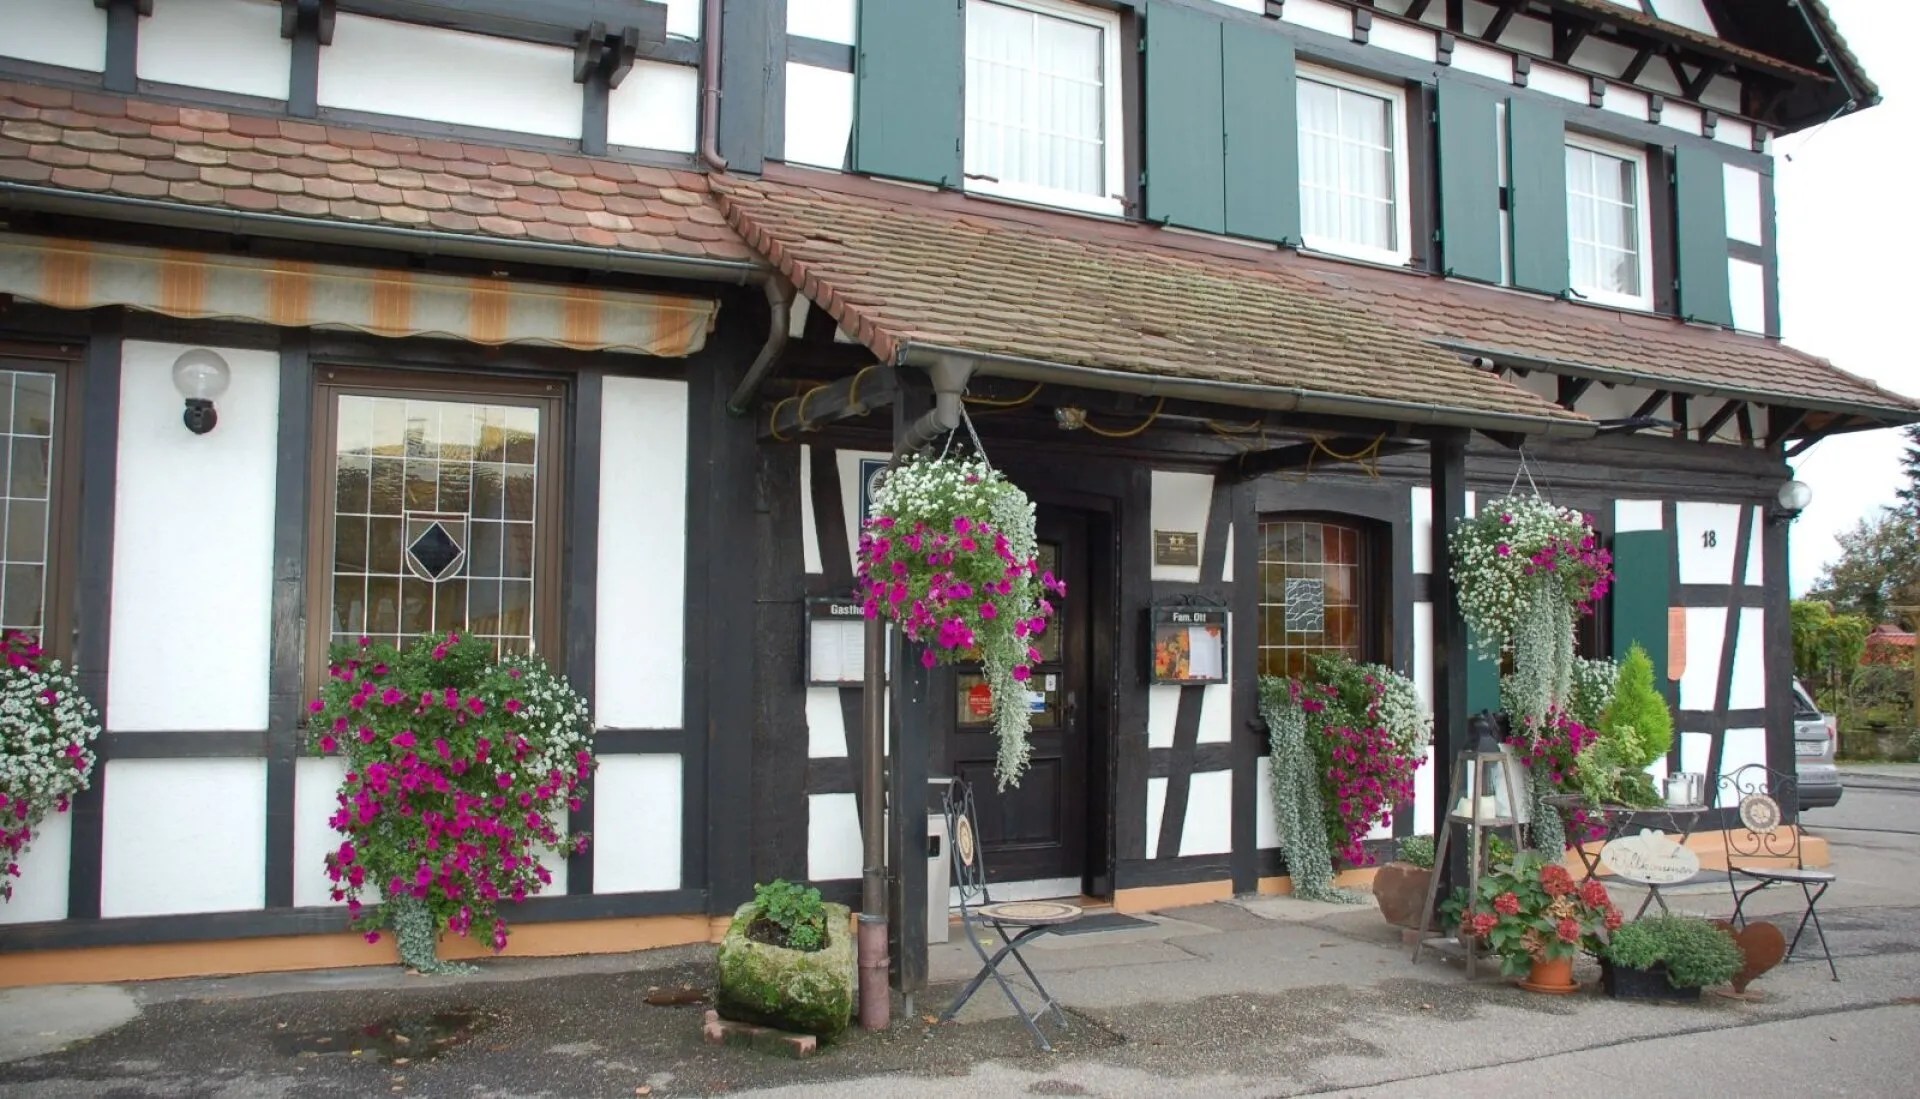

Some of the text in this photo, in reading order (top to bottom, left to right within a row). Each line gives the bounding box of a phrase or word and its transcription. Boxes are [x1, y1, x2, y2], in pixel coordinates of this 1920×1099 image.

[1701, 529, 1717, 548] 18
[830, 603, 865, 615] Gastho
[1172, 611, 1192, 622] Fam.
